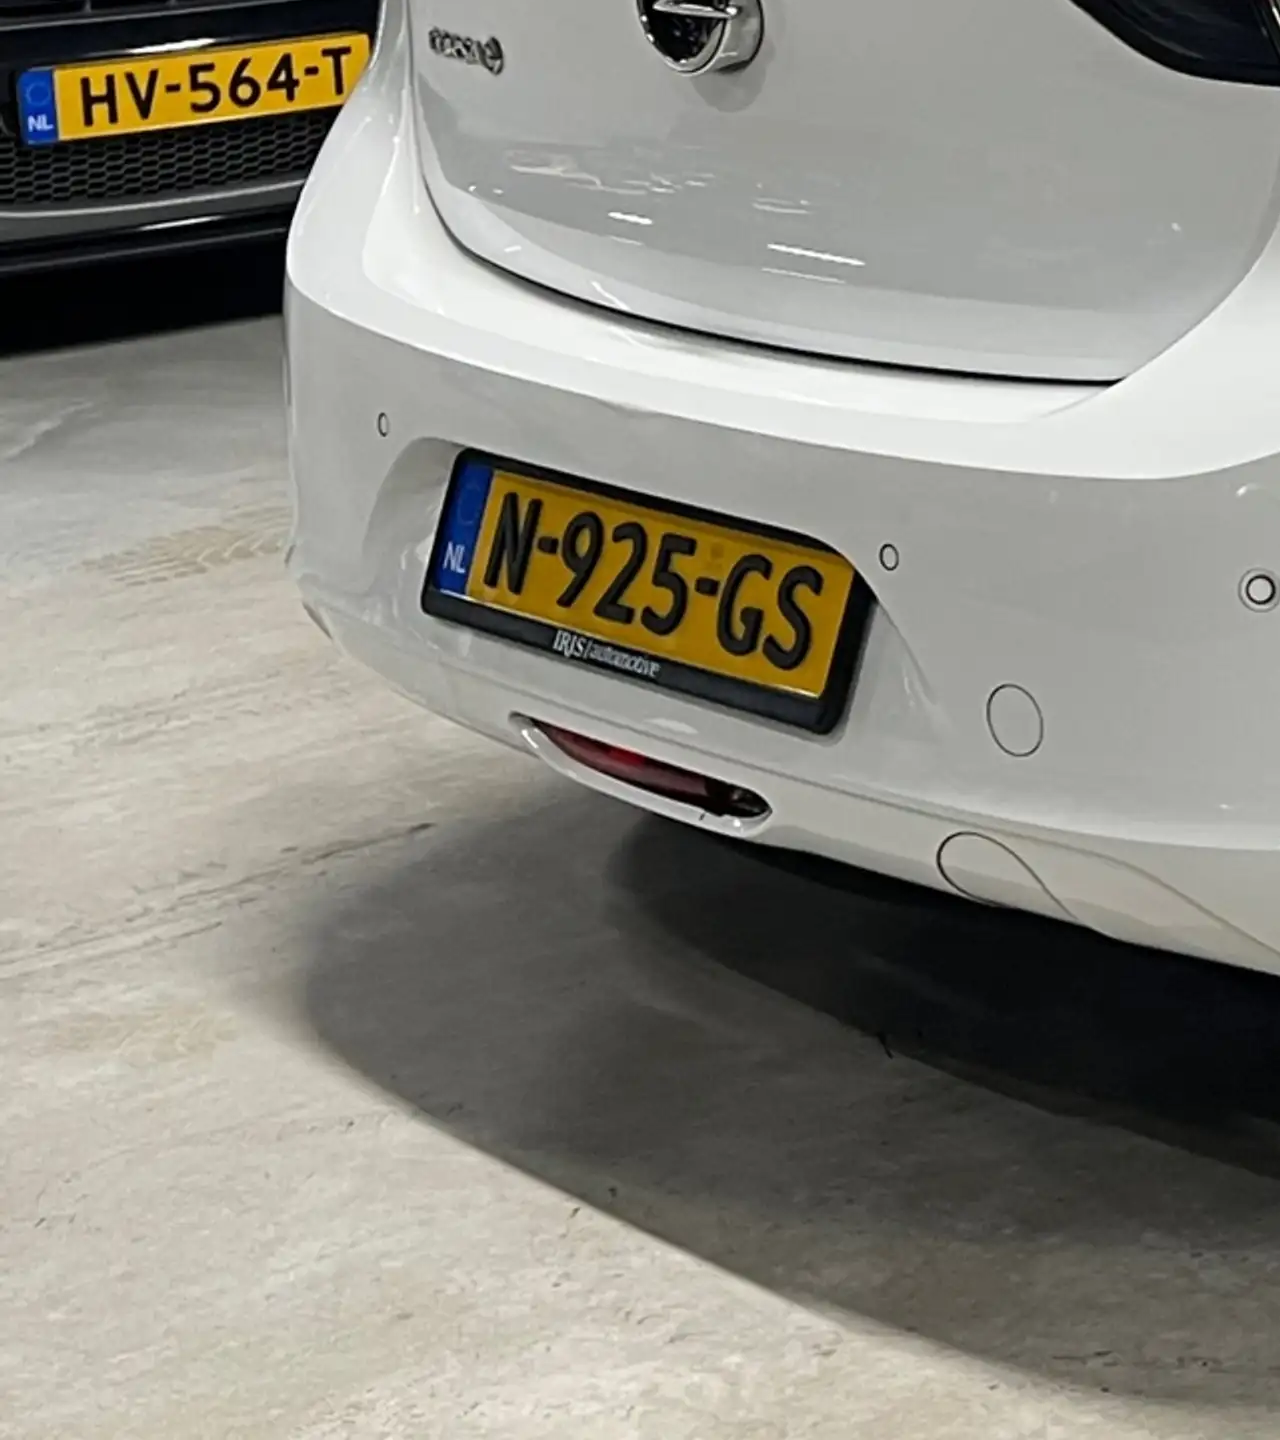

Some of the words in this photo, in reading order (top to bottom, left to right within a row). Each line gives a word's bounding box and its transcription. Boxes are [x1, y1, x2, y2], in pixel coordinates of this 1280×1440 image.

[28, 114, 54, 132] NL
[79, 46, 352, 127] HV-564-T
[443, 541, 466, 574] NL
[483, 492, 824, 670] N-925-GS
